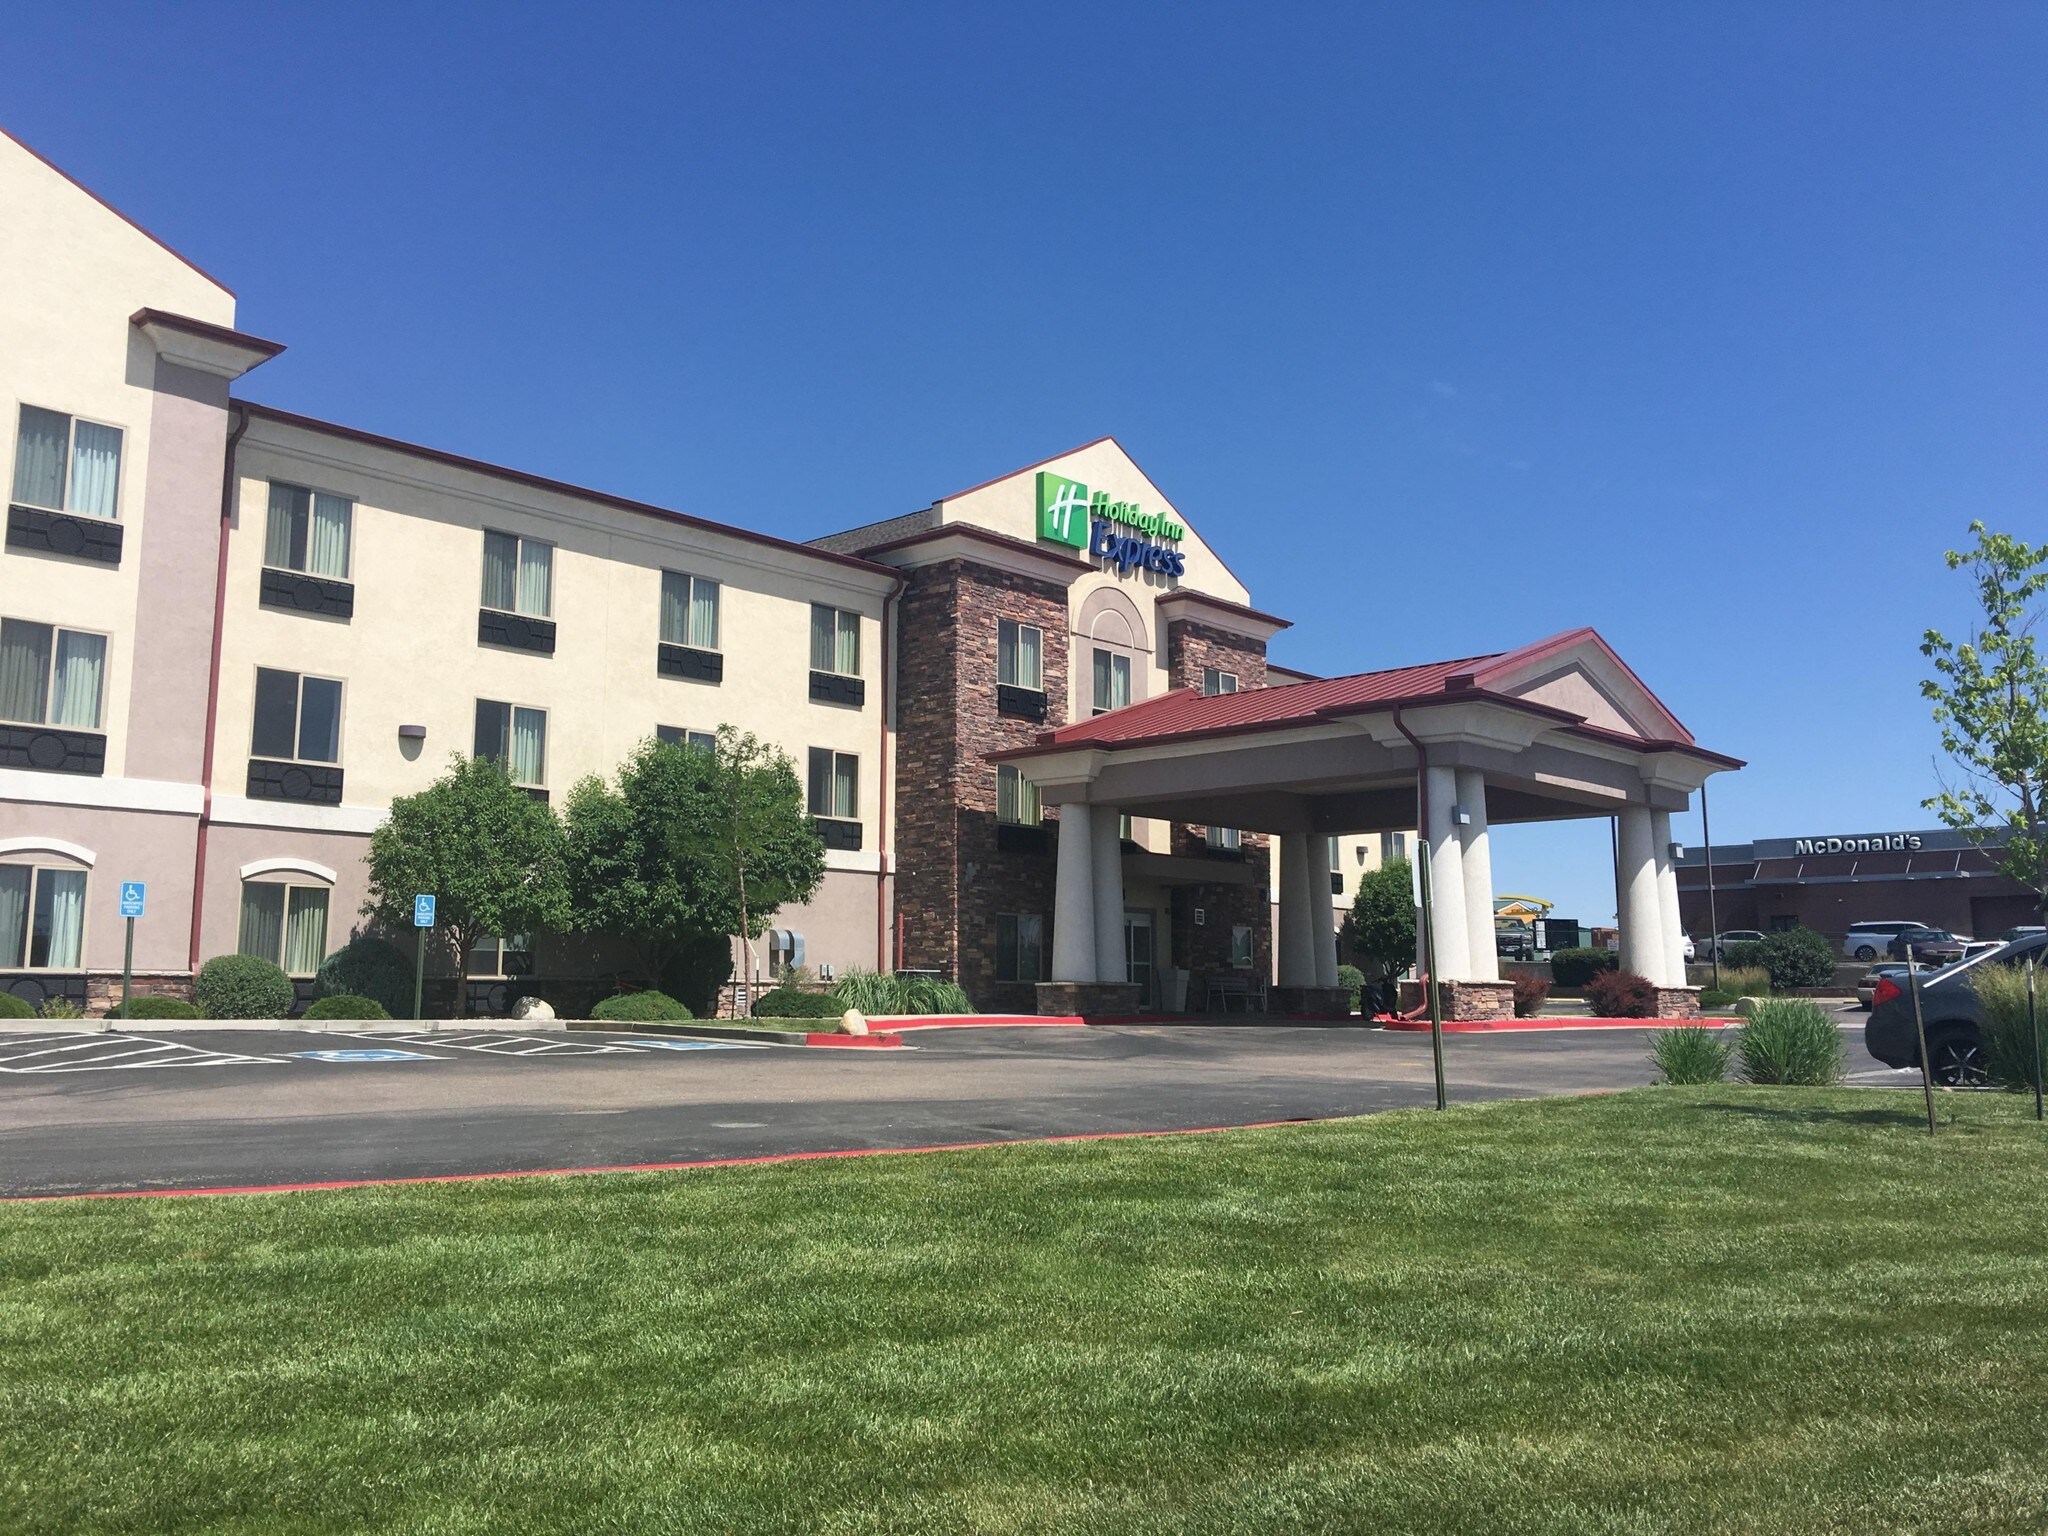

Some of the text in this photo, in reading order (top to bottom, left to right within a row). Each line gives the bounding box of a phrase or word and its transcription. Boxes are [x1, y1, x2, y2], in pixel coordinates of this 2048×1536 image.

[1090, 491, 1184, 541] Holiday Inn
[1089, 520, 1185, 577] Express
[1795, 834, 1922, 855] McDonald's
